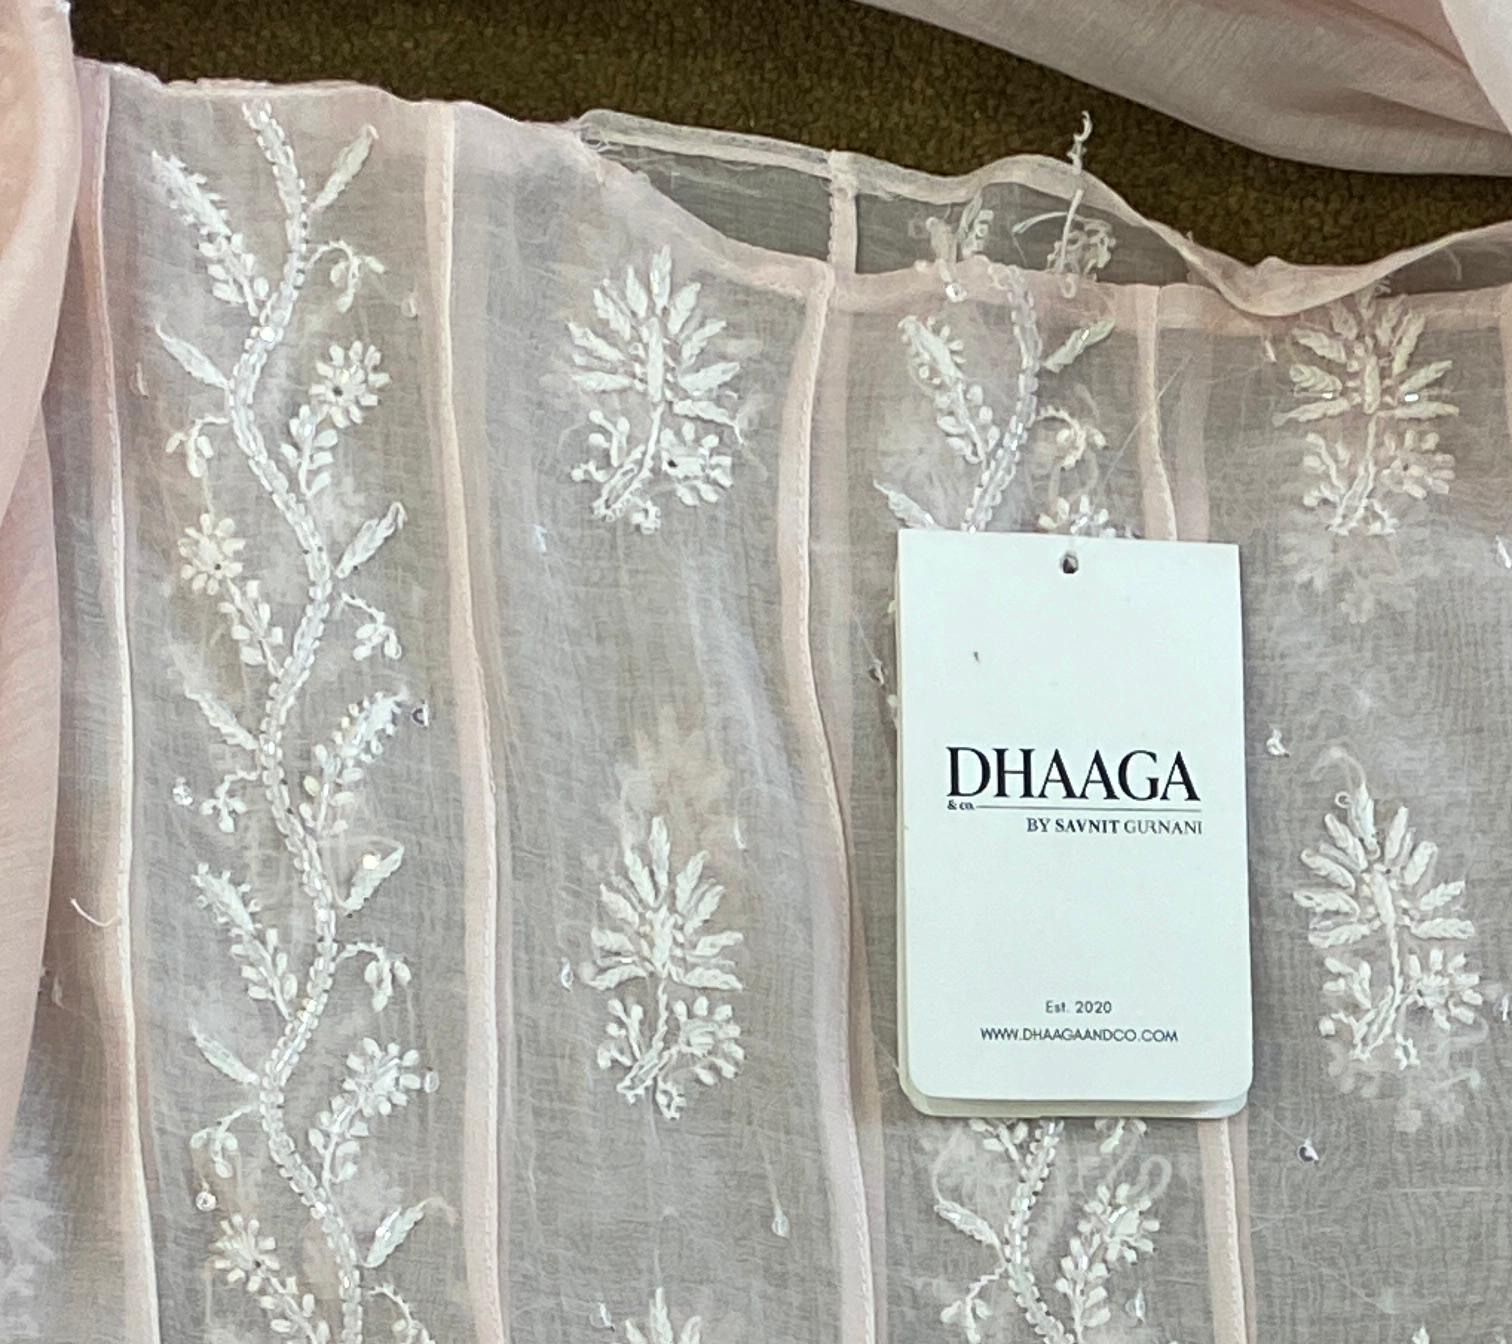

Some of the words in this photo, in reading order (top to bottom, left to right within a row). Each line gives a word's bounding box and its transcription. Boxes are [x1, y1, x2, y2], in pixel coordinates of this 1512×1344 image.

[945, 746, 1201, 802] DHAAGA
[1026, 817, 1051, 833] BY
[1055, 818, 1120, 834] SAVNIT
[1123, 819, 1202, 835] GURNANI
[1075, 1000, 1112, 1014] 2020
[980, 1027, 1179, 1042] WWW.DHAAGAANDCO.COM
